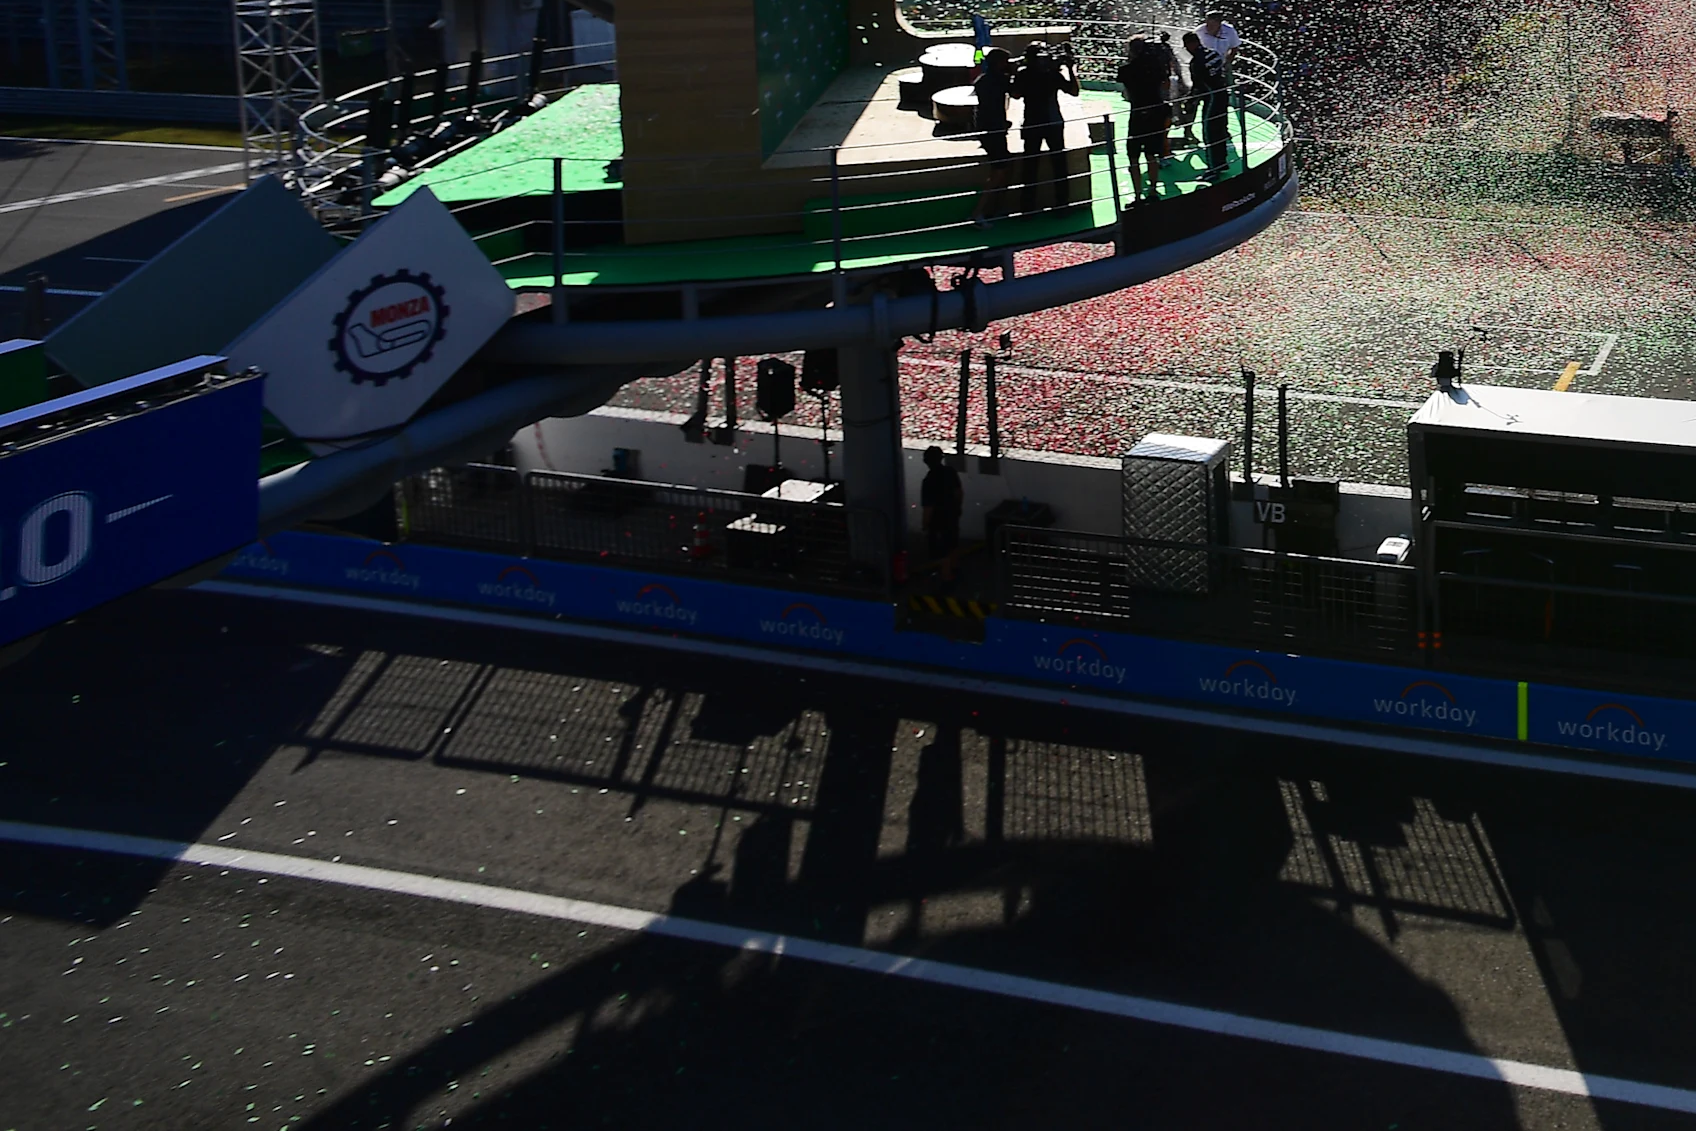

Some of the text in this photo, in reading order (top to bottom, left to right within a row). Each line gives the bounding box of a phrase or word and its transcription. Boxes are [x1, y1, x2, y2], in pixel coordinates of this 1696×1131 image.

[371, 296, 430, 328] MONZA
[1256, 501, 1286, 524] VB
[345, 566, 421, 590] workday
[477, 580, 557, 607] workday
[615, 598, 699, 626] workday
[759, 618, 845, 646] workday
[1033, 654, 1127, 685] workday
[1199, 676, 1298, 707] workday
[1373, 697, 1477, 728] workday
[1557, 720, 1667, 752] workday
